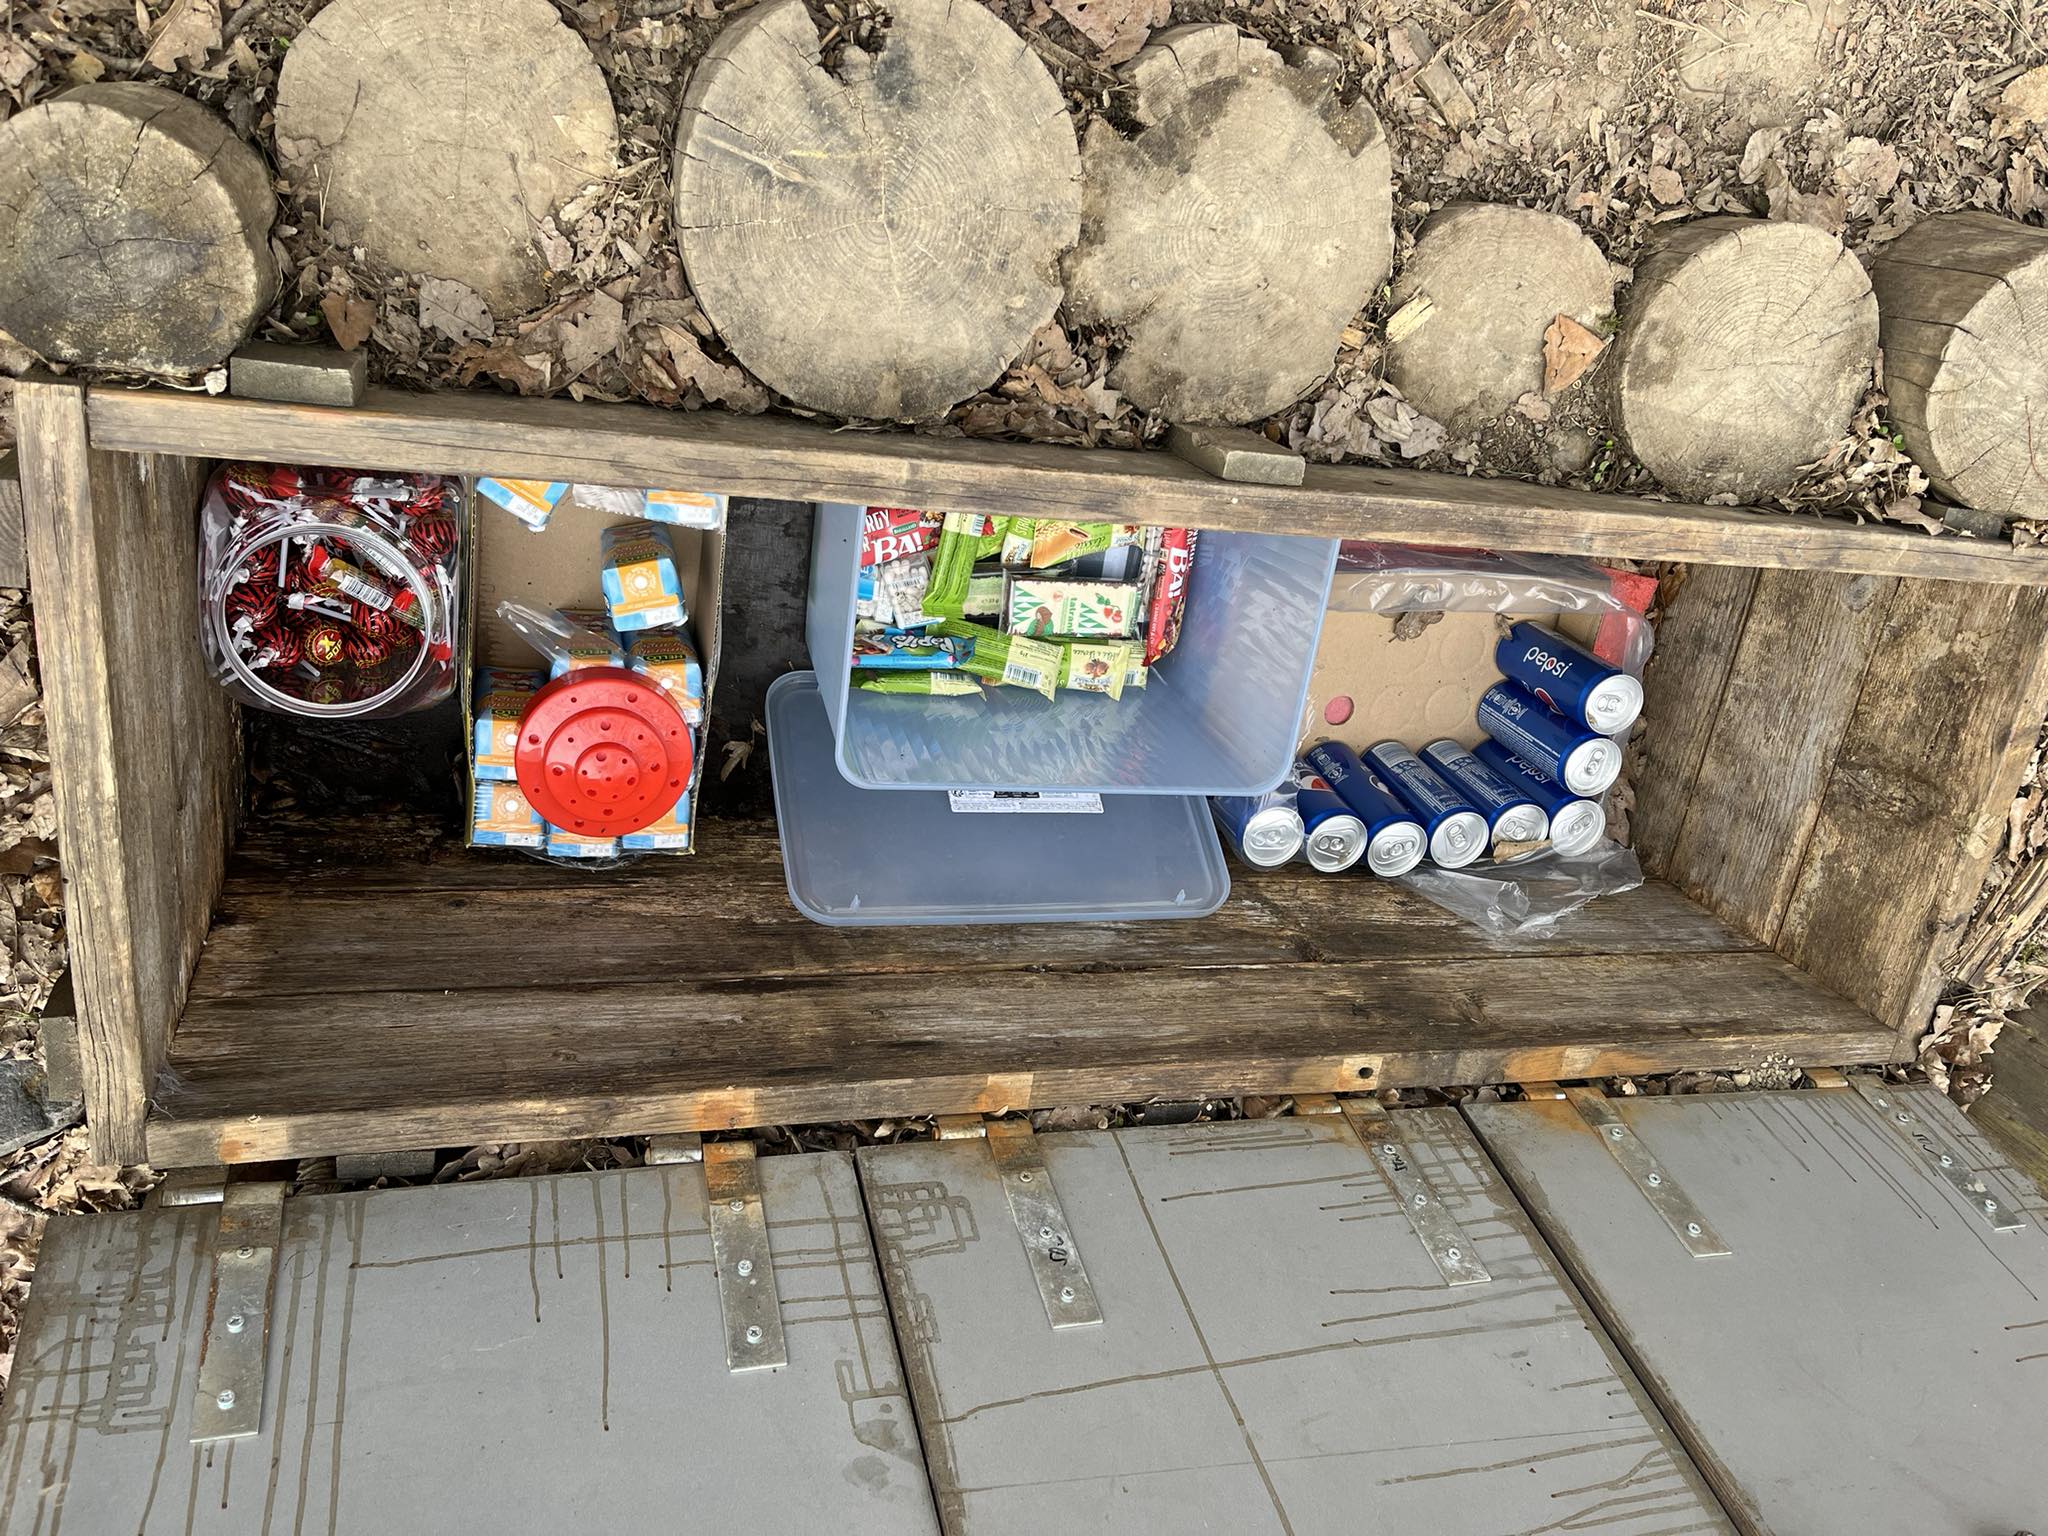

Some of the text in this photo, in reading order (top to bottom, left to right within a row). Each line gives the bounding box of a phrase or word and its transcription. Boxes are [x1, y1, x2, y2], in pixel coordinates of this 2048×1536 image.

[864, 509, 890, 534] RGY
[871, 532, 923, 565] BA!
[1168, 547, 1189, 599] BA!
[1523, 646, 1573, 678] pepsi
[1505, 755, 1551, 783] pepsi
